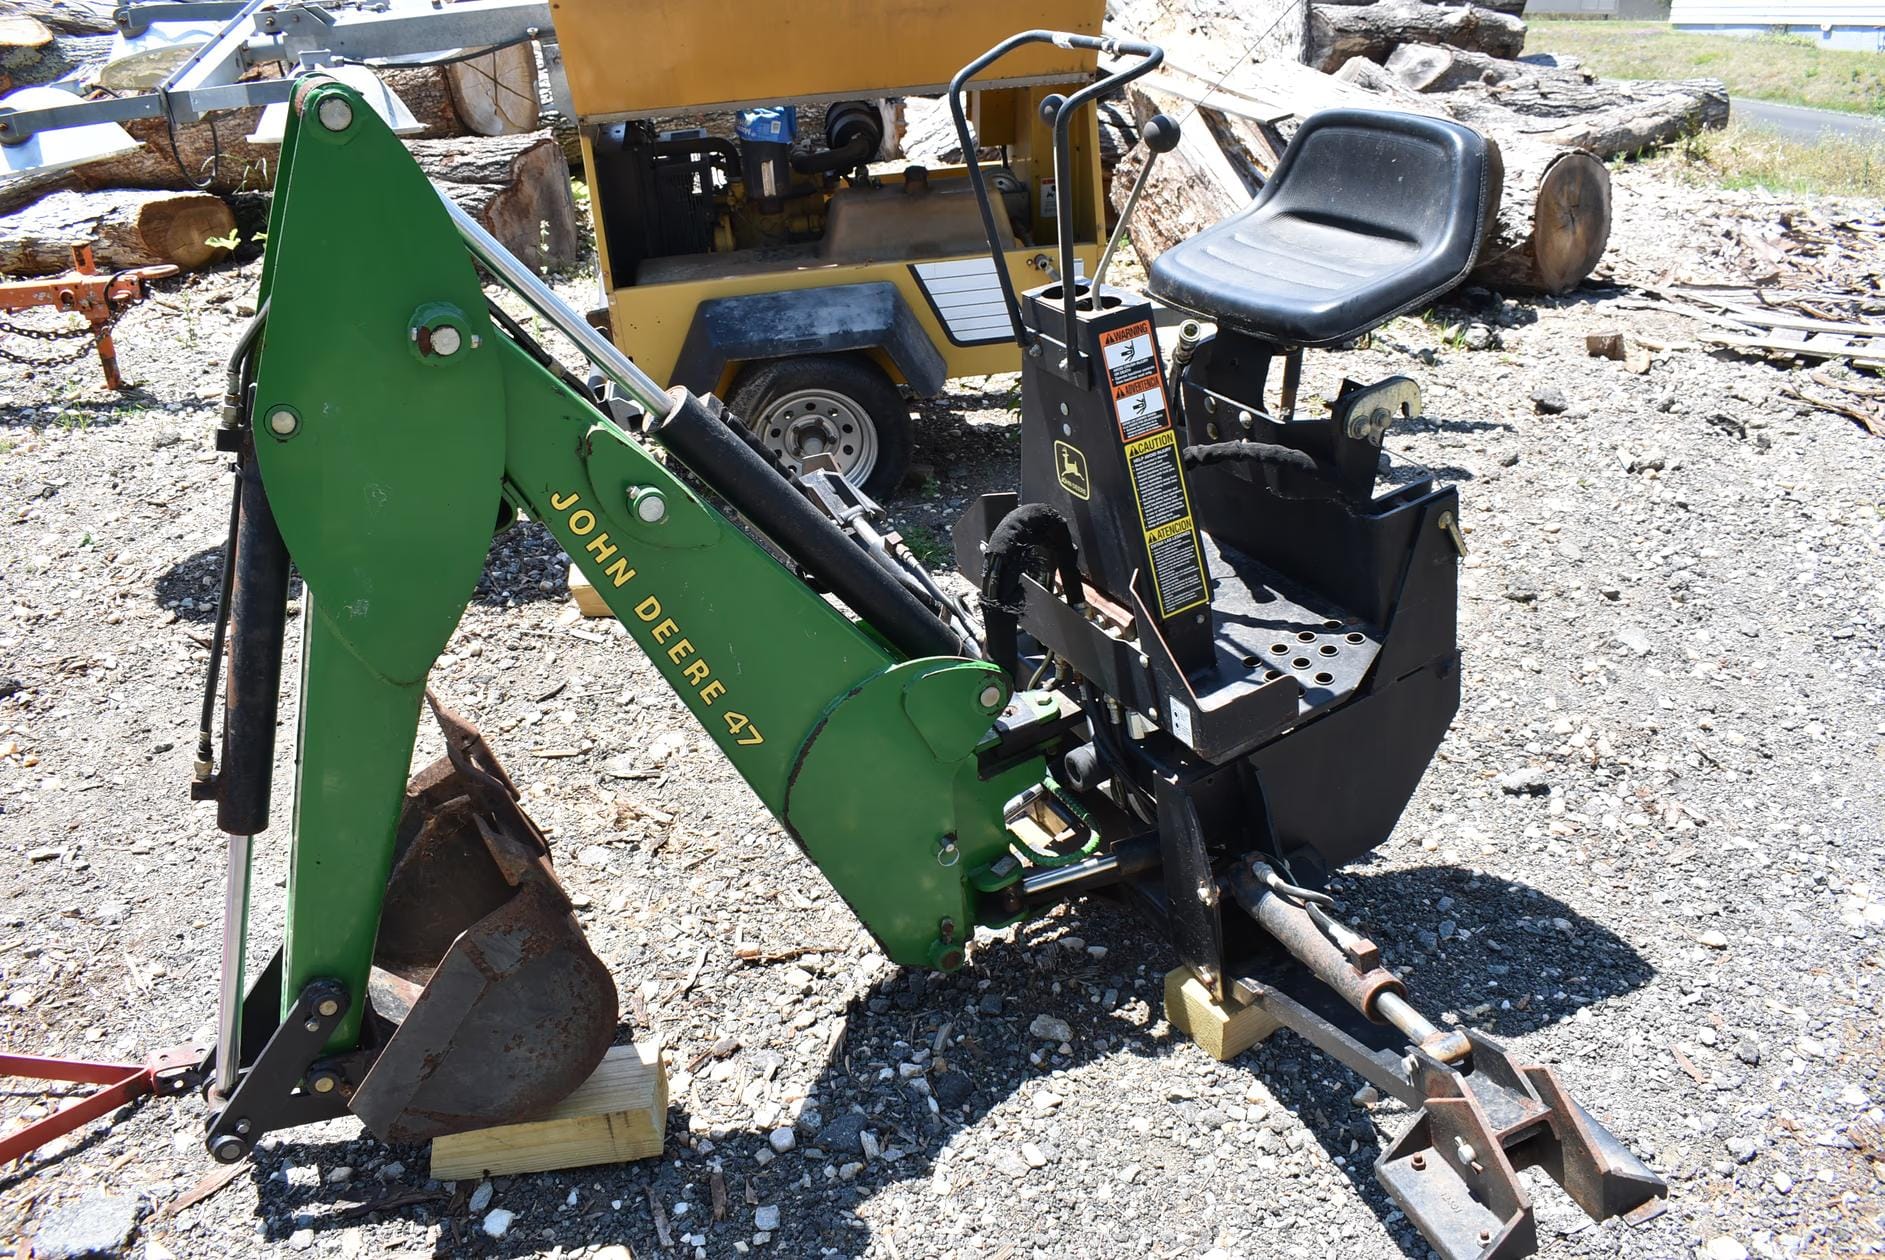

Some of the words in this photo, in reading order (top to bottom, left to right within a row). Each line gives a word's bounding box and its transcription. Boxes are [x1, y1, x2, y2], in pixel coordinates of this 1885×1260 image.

[1114, 322, 1148, 341] WARNING
[1125, 375, 1160, 395] ADVERTENCIA
[1138, 432, 1174, 454] CAUTION
[1157, 519, 1192, 540] ATENCION
[551, 492, 636, 588] JOHN
[634, 595, 727, 706] DEERE
[723, 710, 765, 746] 47
